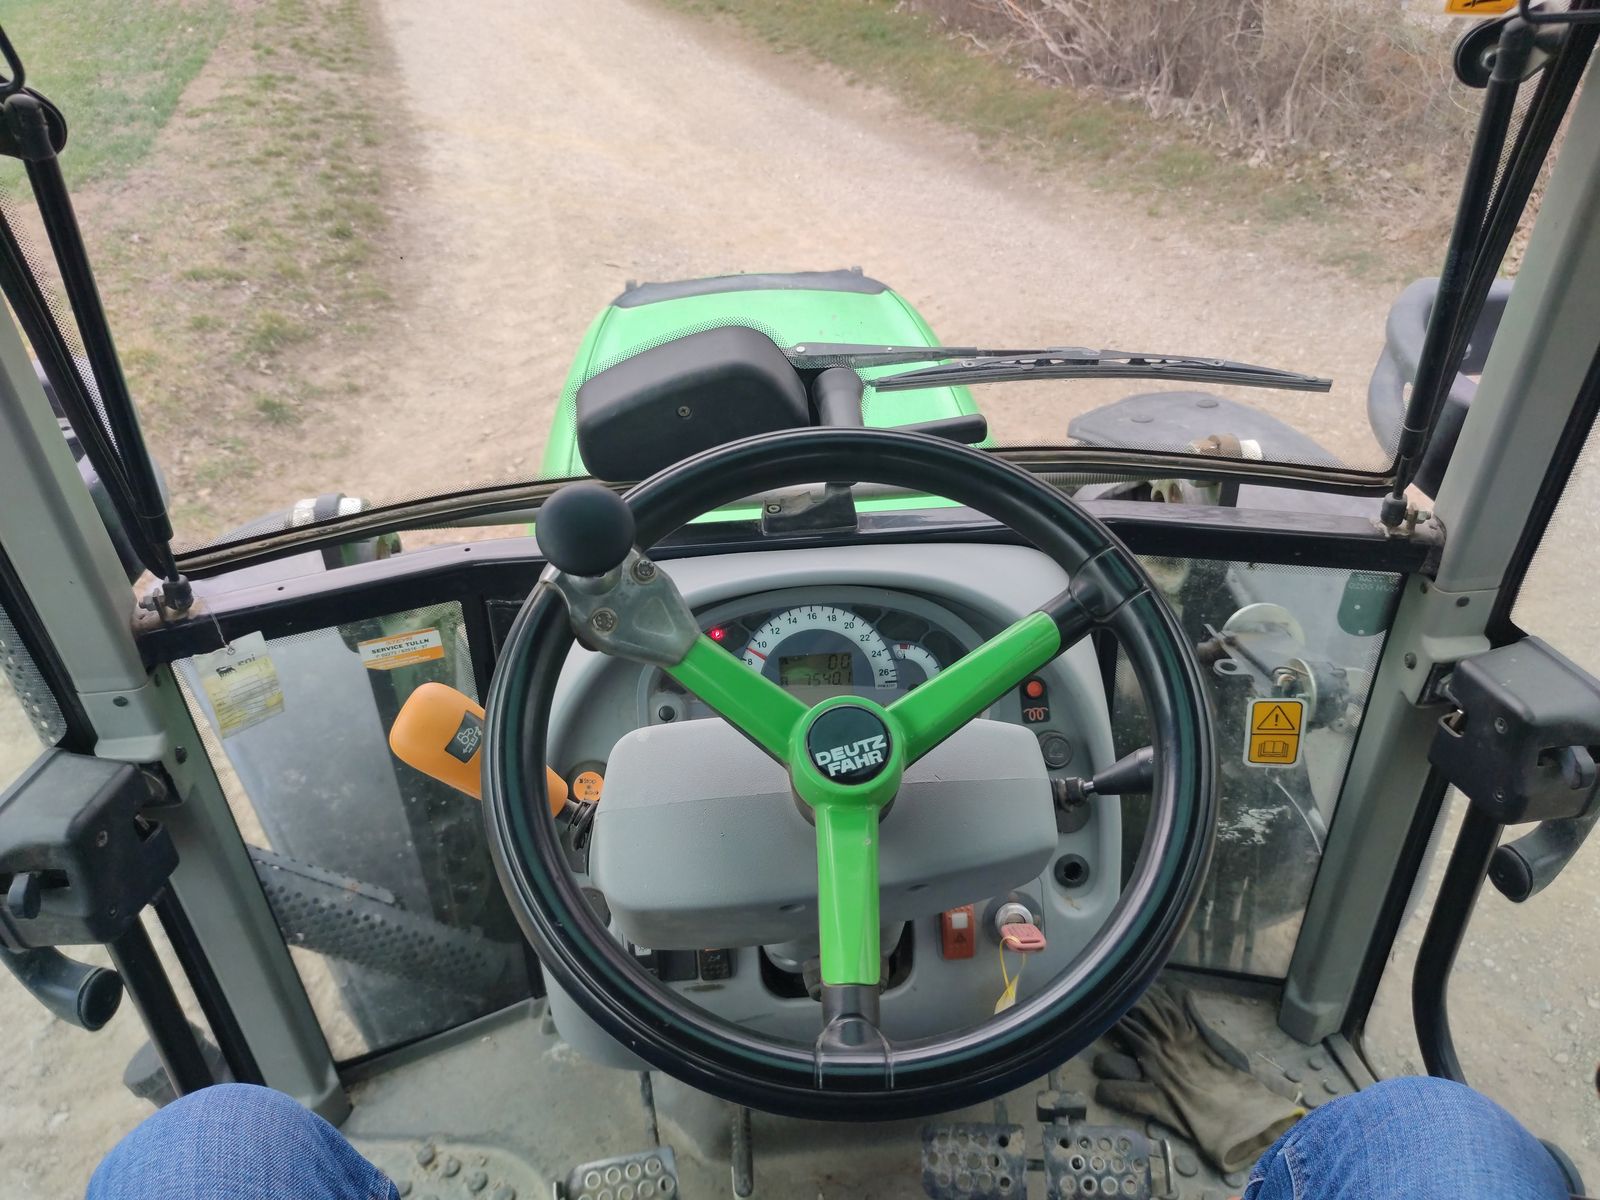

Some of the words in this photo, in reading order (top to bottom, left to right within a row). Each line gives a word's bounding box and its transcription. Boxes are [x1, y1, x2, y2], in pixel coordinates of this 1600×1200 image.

[807, 612, 817, 620] 16
[826, 614, 837, 622] 18
[787, 617, 797, 625] 14
[844, 621, 855, 630] 20
[770, 627, 780, 635] 12
[860, 634, 870, 642] 22
[371, 643, 404, 655] SERVICE
[406, 638, 430, 648] TULLN
[757, 641, 767, 649] 10
[871, 650, 882, 658] 24
[747, 658, 753, 666] 8
[878, 668, 890, 677] 26
[815, 734, 887, 767] DEUTZ
[827, 749, 884, 777] FAHR
